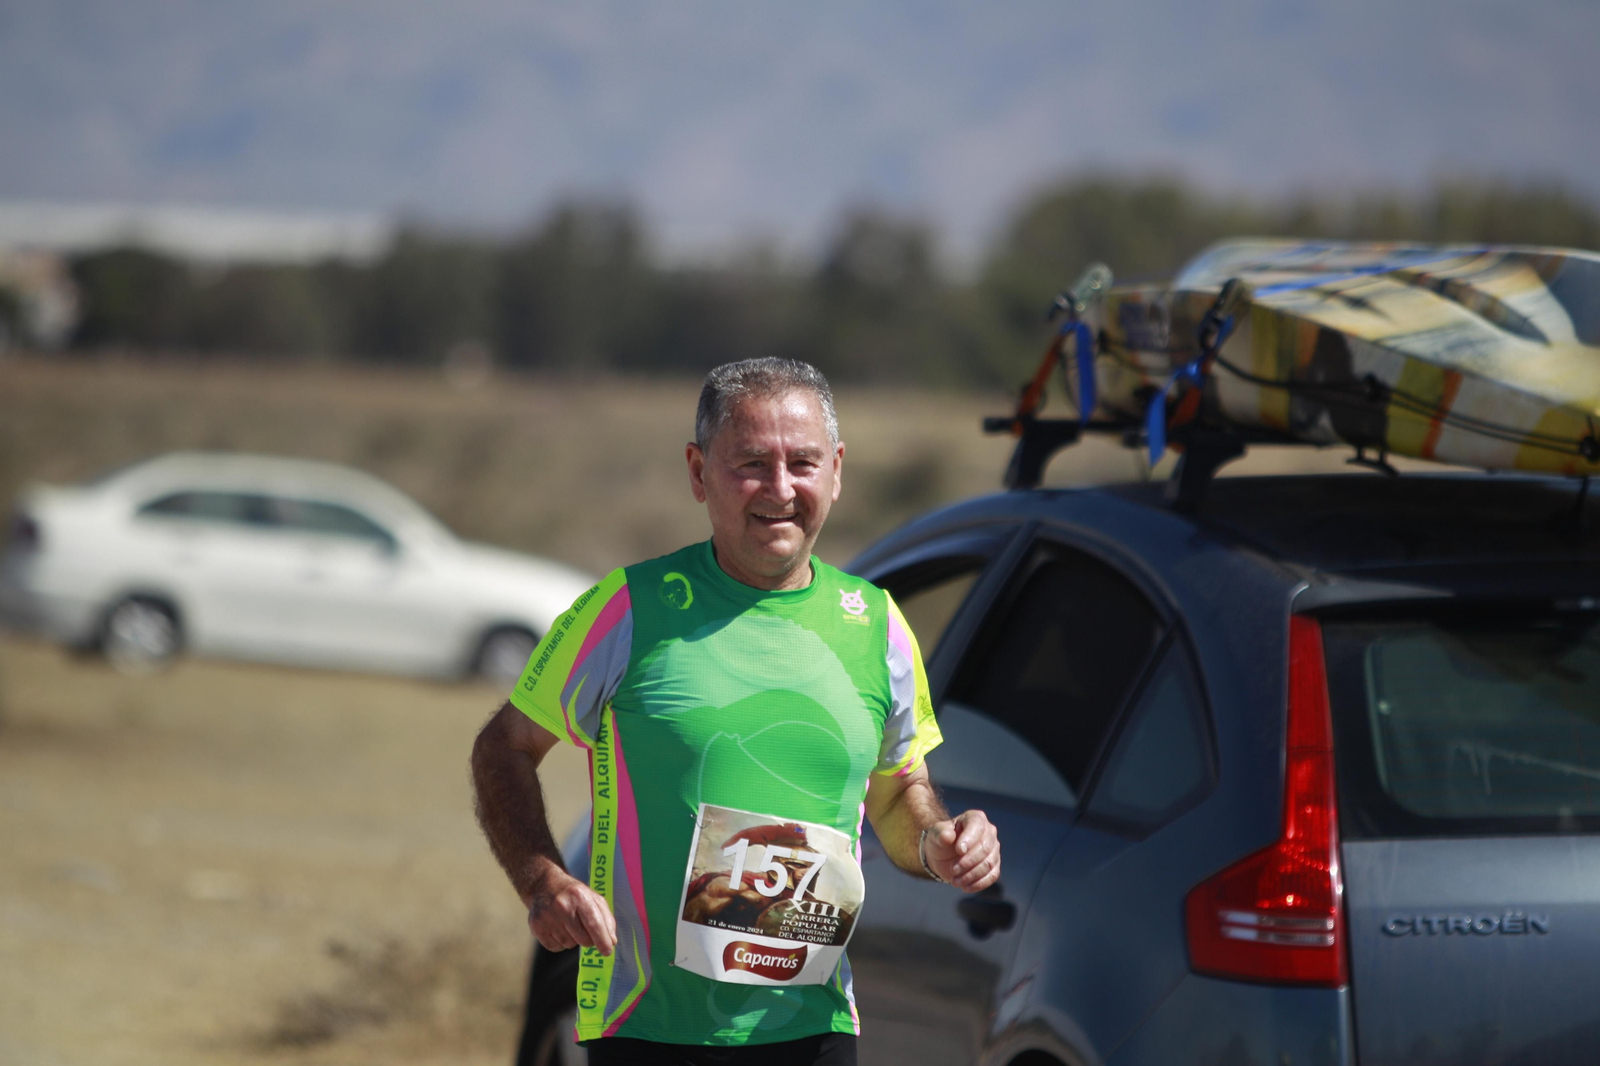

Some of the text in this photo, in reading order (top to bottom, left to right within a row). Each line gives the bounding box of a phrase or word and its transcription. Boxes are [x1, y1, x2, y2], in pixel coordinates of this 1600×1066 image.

[523, 675, 538, 692] C.D.
[532, 629, 565, 677] ESPARTANOS
[562, 614, 576, 630] DEL
[723, 838, 827, 901] 157
[579, 977, 601, 1010] C.D.
[597, 809, 610, 844] DEL
[785, 898, 843, 919] XIII
[707, 918, 717, 926] 21
[746, 926, 764, 934] 2024
[782, 919, 837, 933] POPULAR
[783, 912, 840, 926] CARRERA
[1381, 909, 1550, 936] CITROËN
[778, 931, 795, 939] DEL
[792, 927, 836, 938] ESPARTANOS
